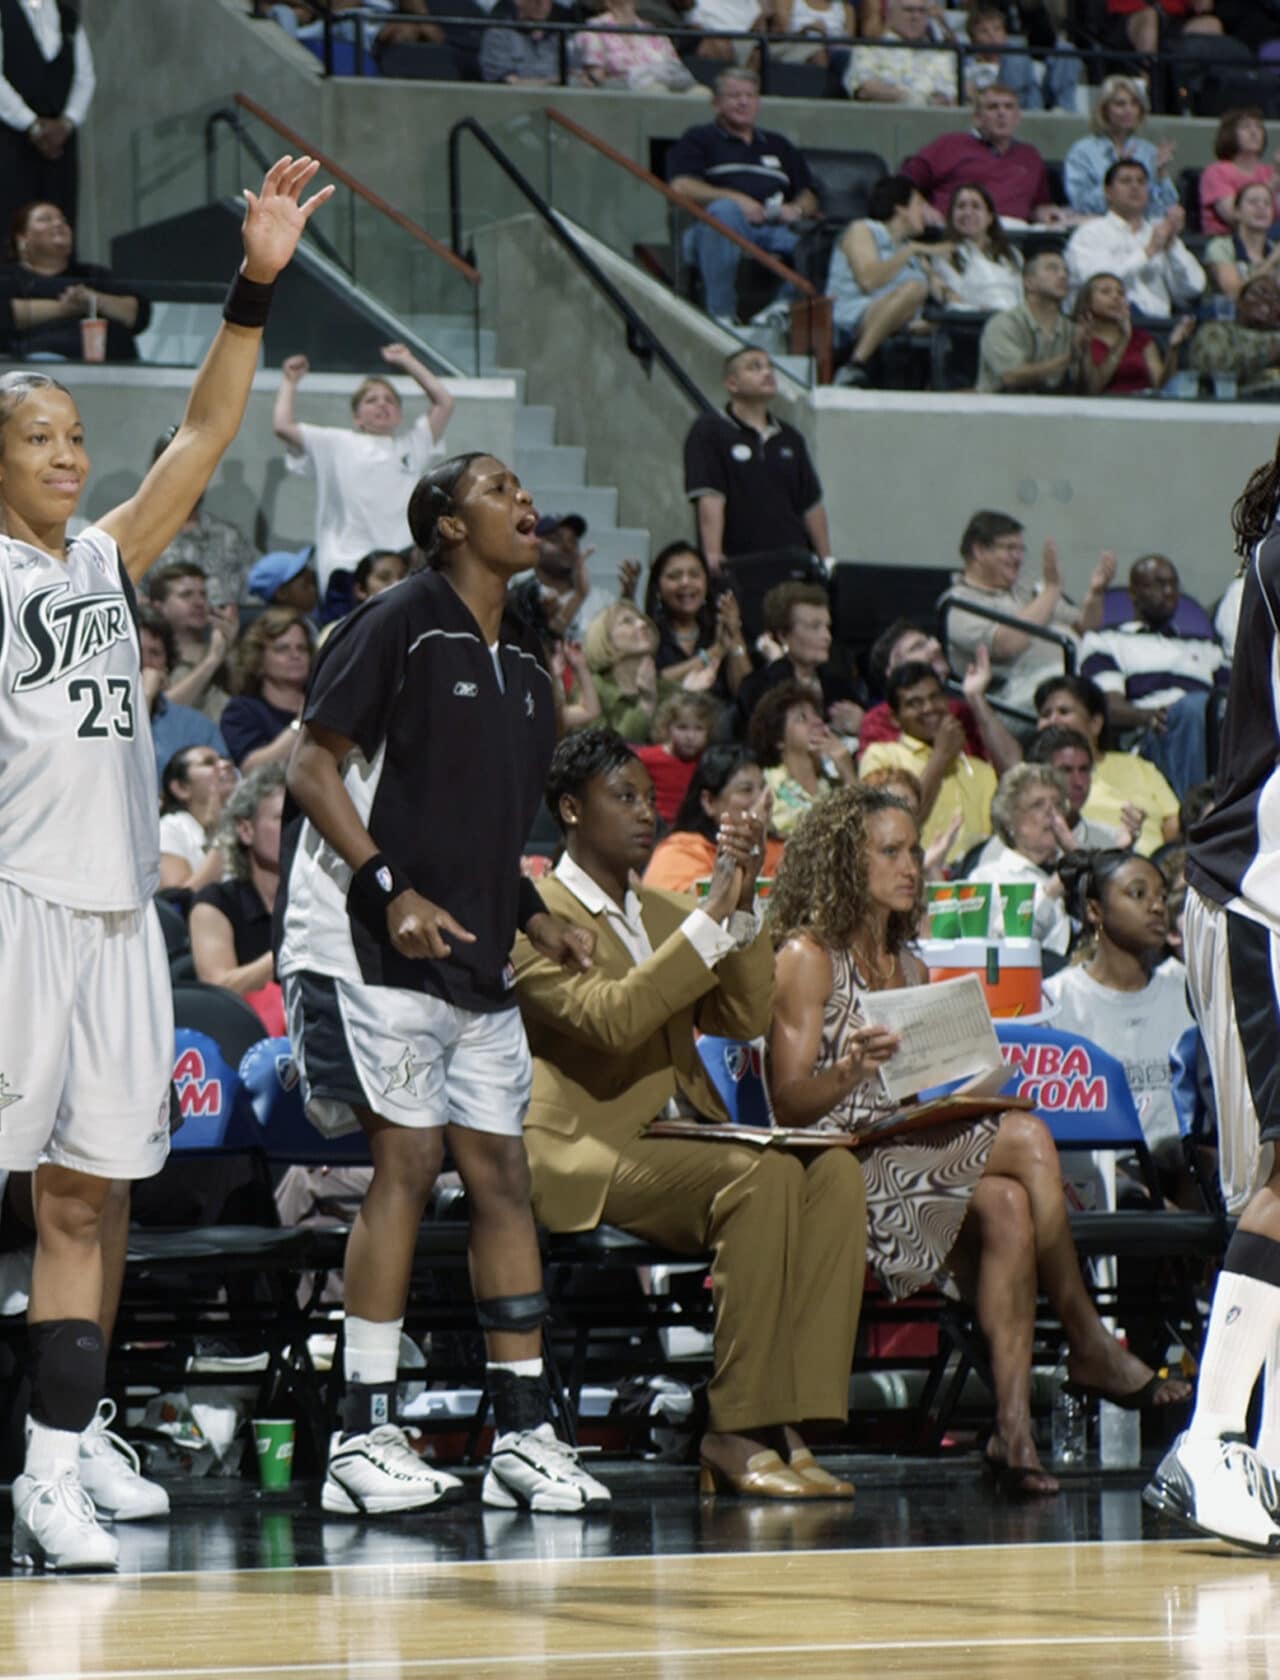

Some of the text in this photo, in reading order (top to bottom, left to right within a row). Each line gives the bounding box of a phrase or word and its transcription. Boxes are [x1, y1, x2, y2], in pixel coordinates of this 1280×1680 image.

[11, 581, 129, 694] STAR
[67, 677, 135, 740] 23
[1001, 1045, 1091, 1078] NBA
